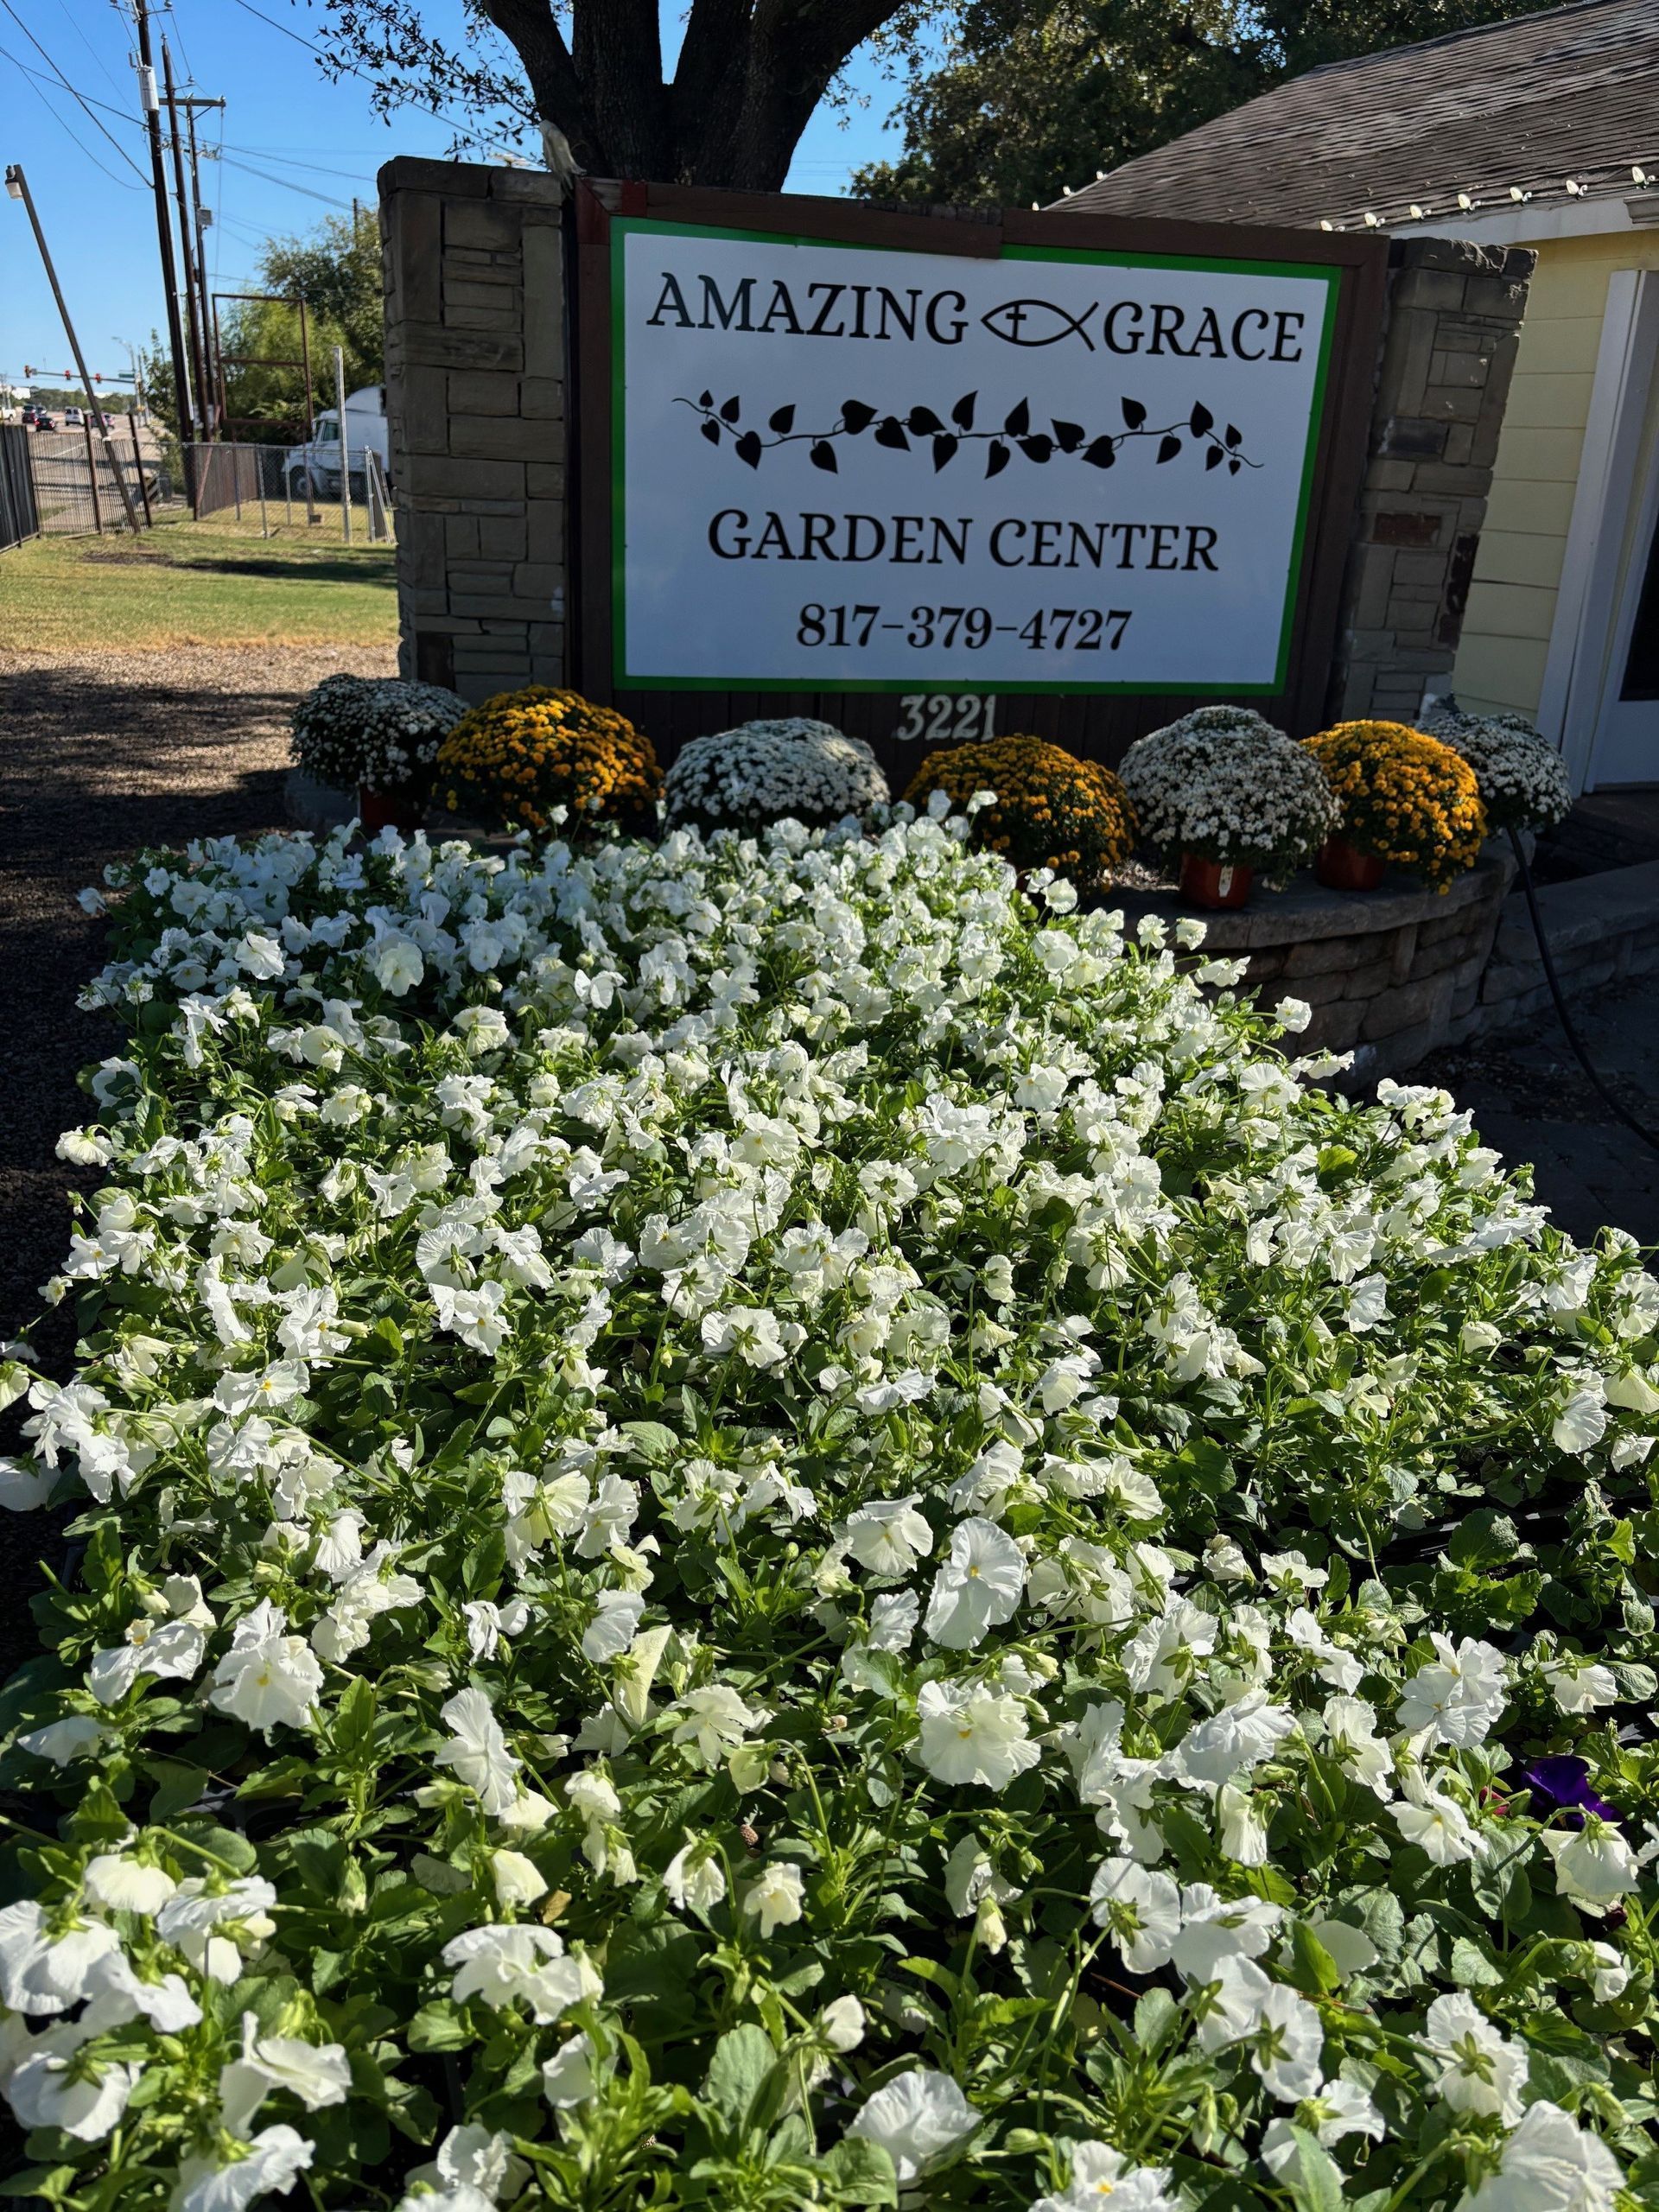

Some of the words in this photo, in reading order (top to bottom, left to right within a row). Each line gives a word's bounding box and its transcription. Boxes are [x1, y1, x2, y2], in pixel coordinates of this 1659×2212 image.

[646, 272, 969, 345] AMAZING
[1104, 302, 1305, 362] GRACE
[709, 510, 973, 564] GARDEN
[989, 519, 1219, 571] CENTER
[797, 604, 1133, 651] 817-379-4727
[897, 694, 996, 742] 3221
